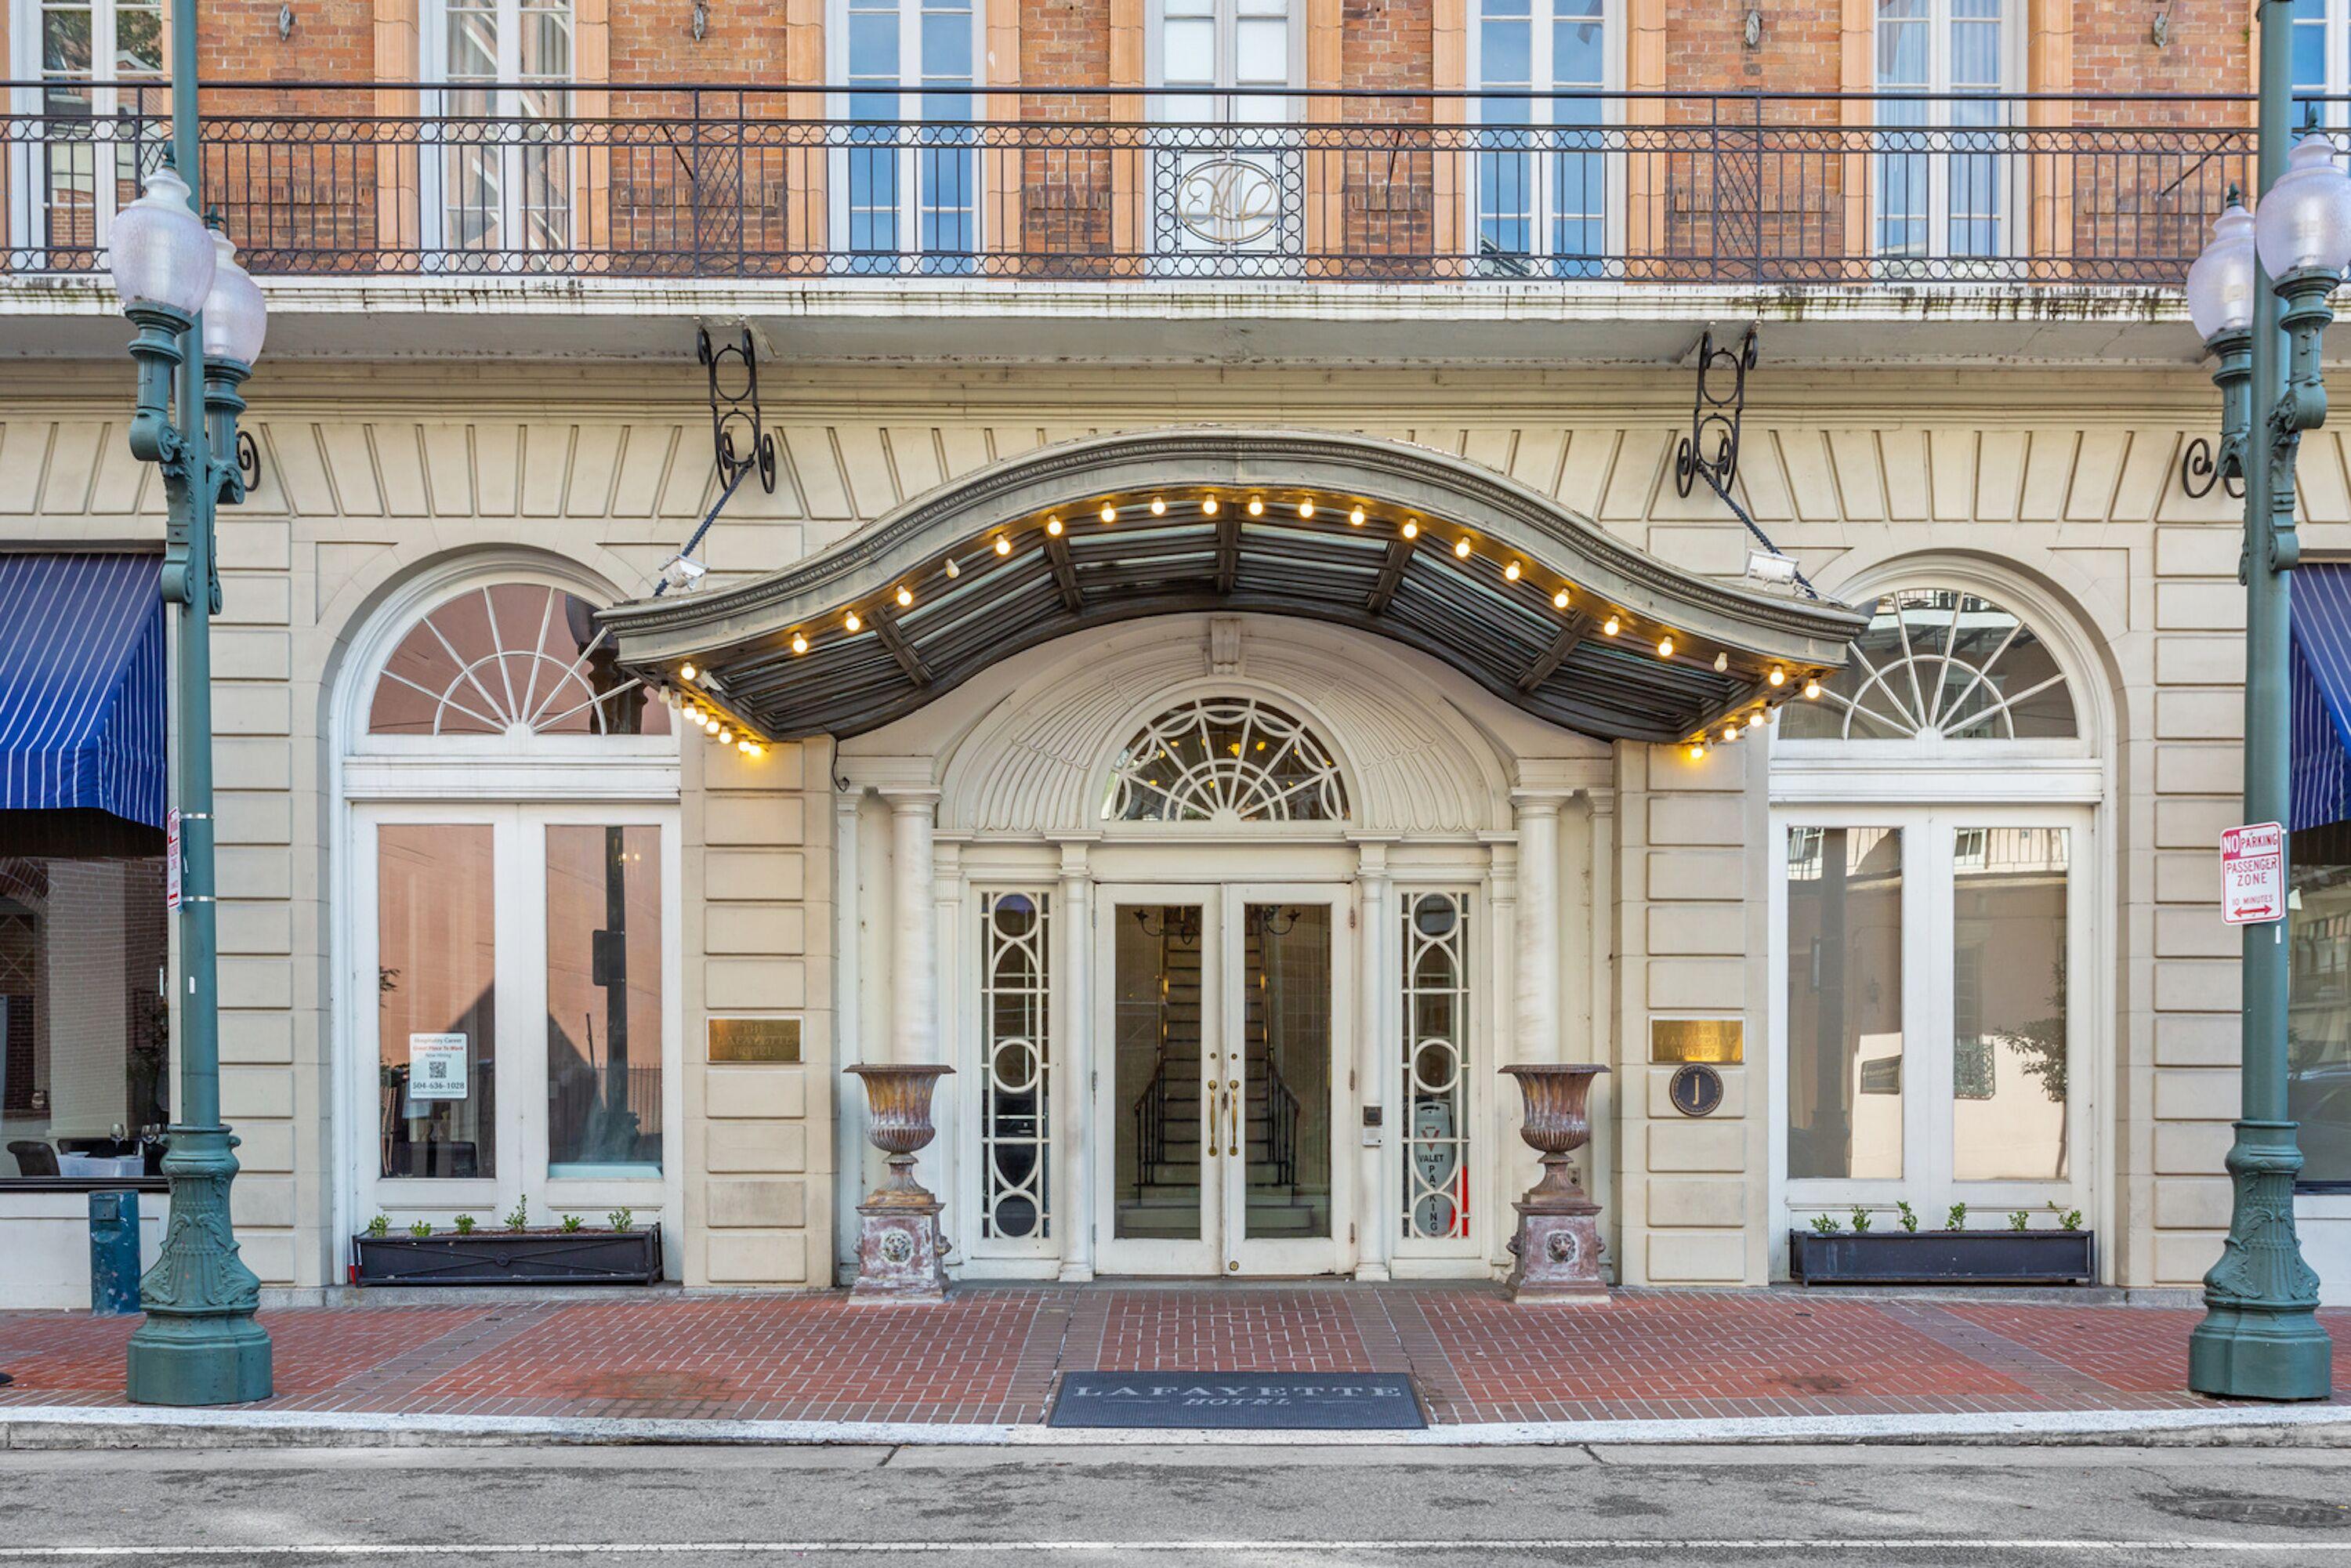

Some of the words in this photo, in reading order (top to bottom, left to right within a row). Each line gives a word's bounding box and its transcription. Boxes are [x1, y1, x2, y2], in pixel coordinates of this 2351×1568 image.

[2223, 835, 2239, 853] NO
[2241, 833, 2277, 849] PARKING
[2226, 857, 2277, 874] PASSENGER
[2237, 872, 2267, 886] ZONE
[2244, 894, 2273, 904] MINUTES
[1418, 1154, 1444, 1163] VALET
[1429, 1165, 1438, 1231] PAKING
[1073, 1385, 1402, 1397] LAFAYETTE
[1182, 1397, 1291, 1407] HOTEL
